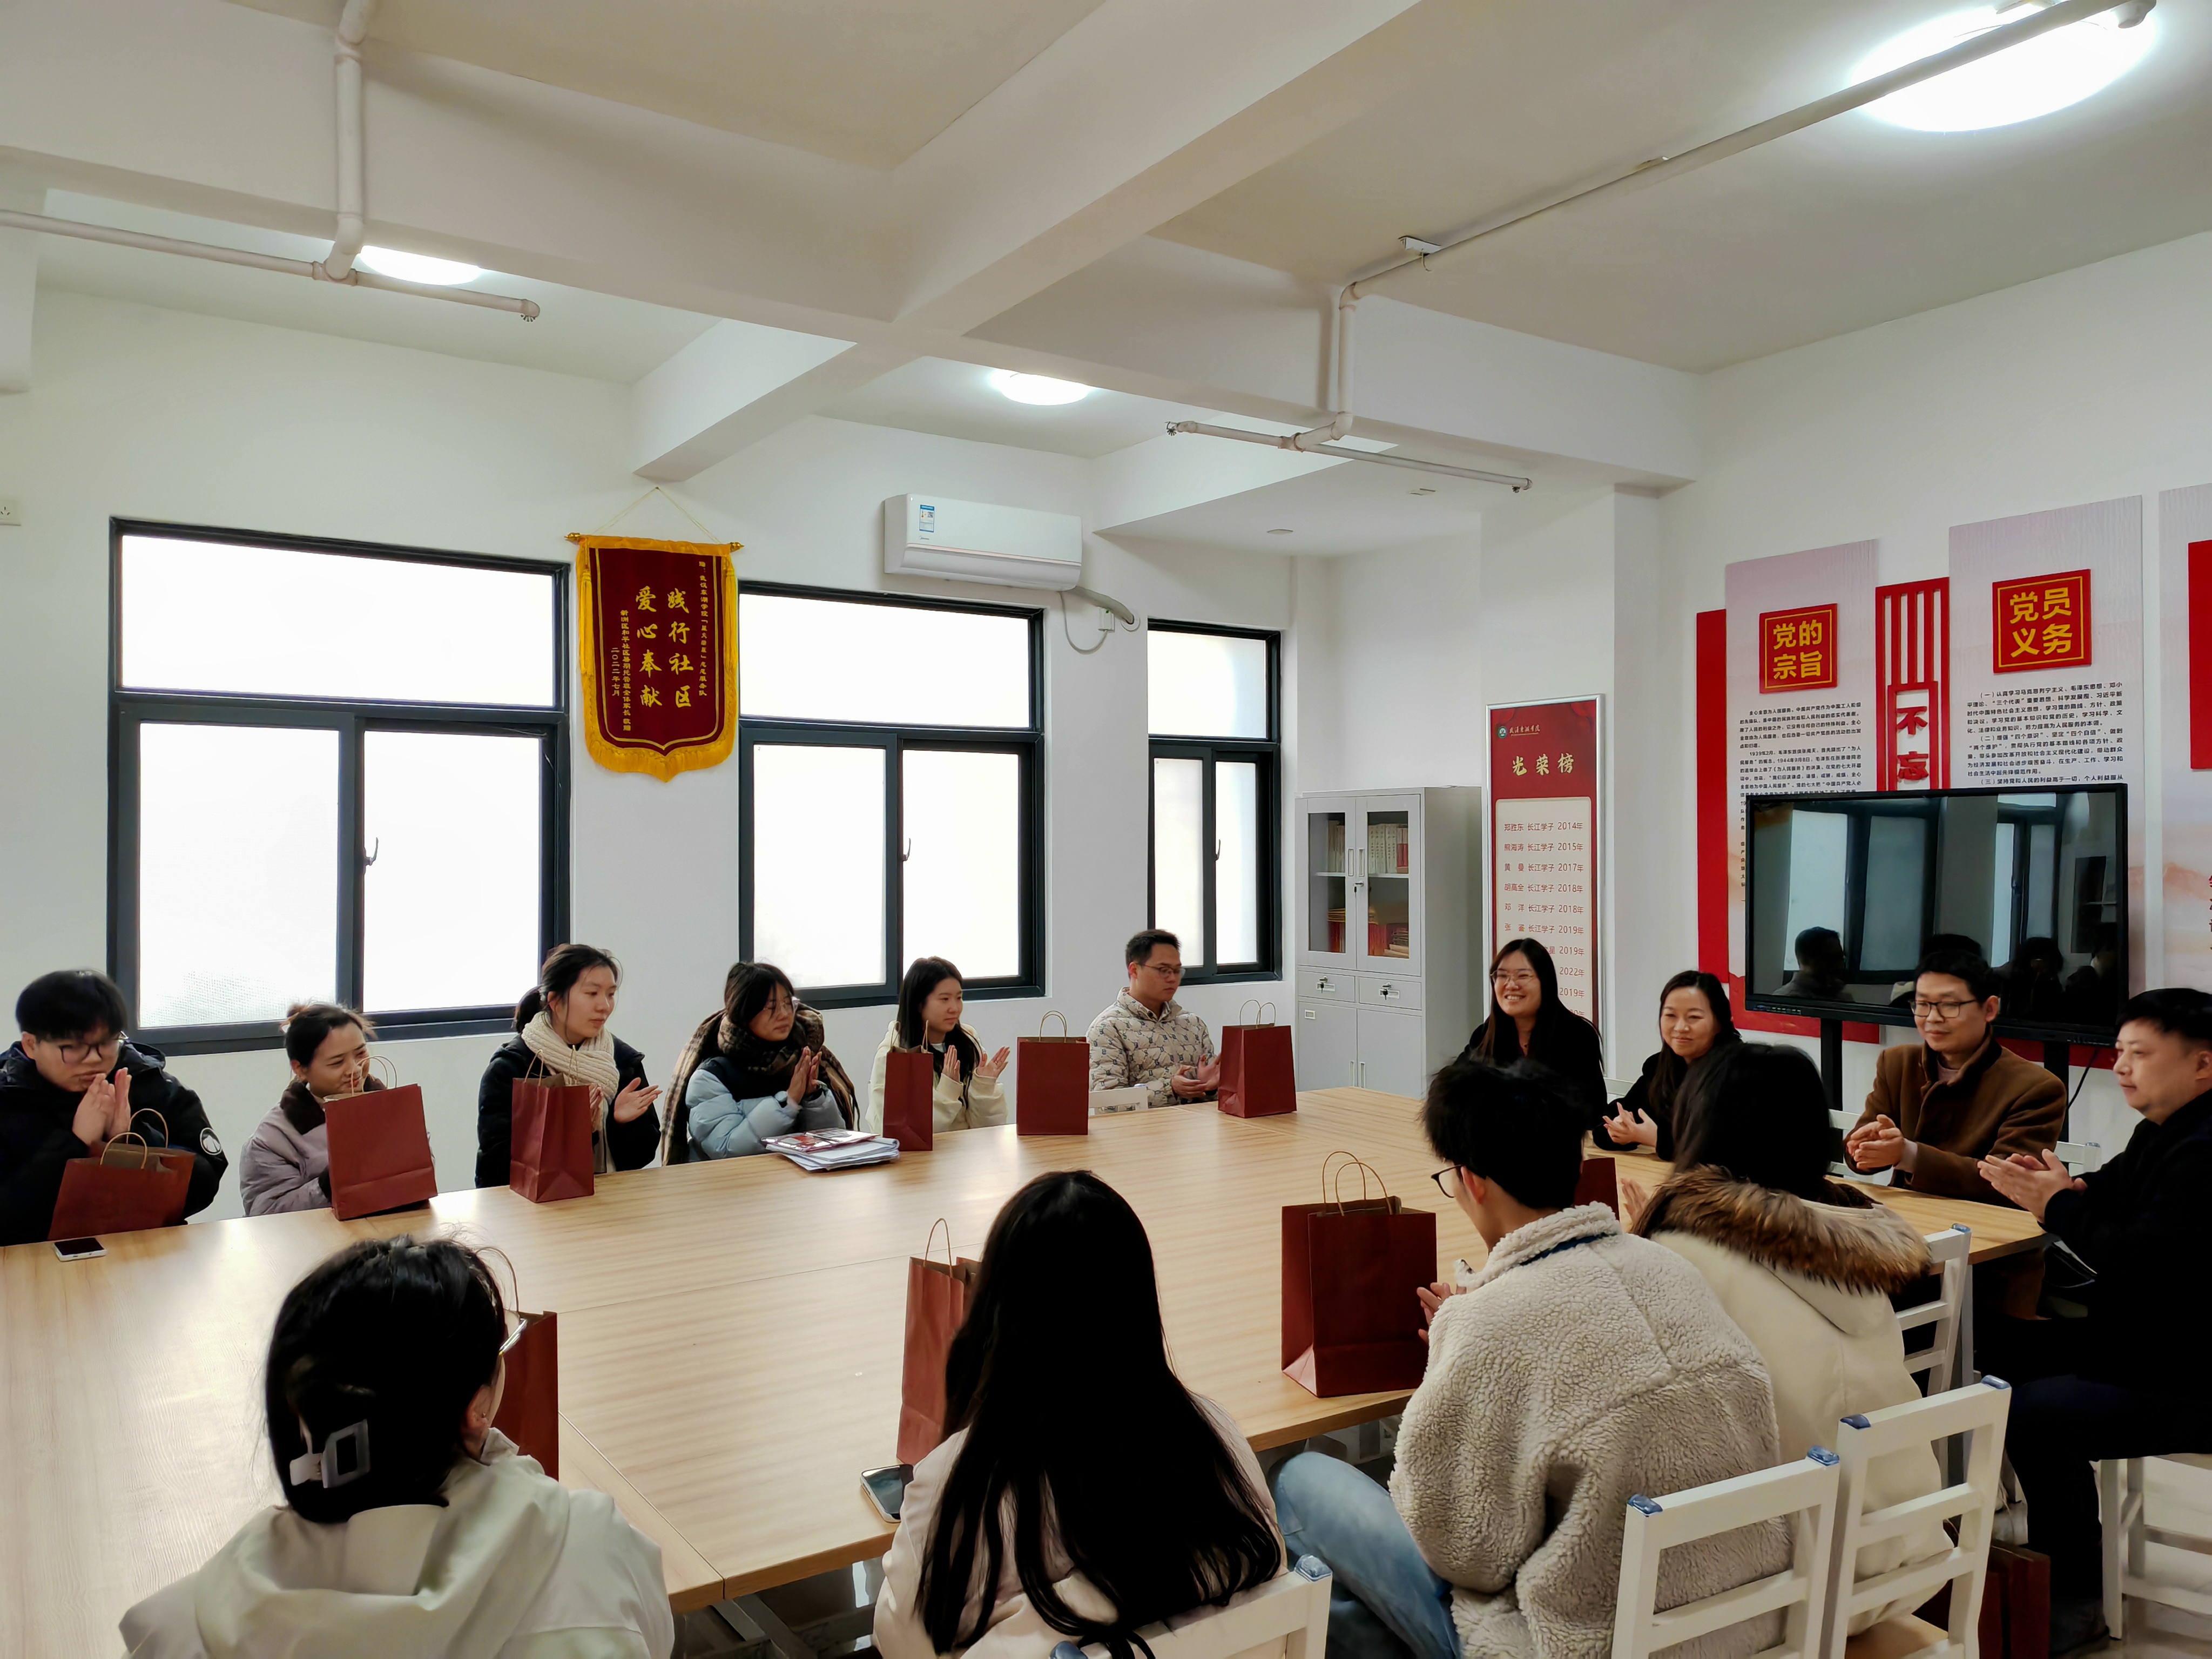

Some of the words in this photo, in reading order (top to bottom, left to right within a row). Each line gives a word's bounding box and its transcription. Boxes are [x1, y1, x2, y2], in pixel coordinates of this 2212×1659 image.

[2009, 587, 2072, 624] 党员
[1773, 620, 1823, 650] 党的
[2010, 624, 2073, 658] 义务
[636, 586, 662, 707] 爱心奉献
[667, 588, 693, 707] 践行社区
[1773, 651, 1823, 680] 宗旨
[1897, 706, 1929, 780] 不忘
[1513, 753, 1574, 776] 光荣榜
[1528, 823, 1554, 831] 长江学子
[1557, 822, 1583, 831] 2014年
[1557, 842, 1584, 851] 2015年
[1528, 864, 1555, 872] 长江学子
[1558, 863, 1584, 872] 2017年
[1528, 884, 1554, 892] 长江学子
[1558, 884, 1583, 893] 2018年
[1528, 904, 1555, 913] 长江学子
[1559, 905, 1584, 914] 2018年
[1528, 925, 1555, 933] 长江学子
[1559, 925, 1584, 935] 2019年
[1559, 946, 1584, 956] 2019年
[1559, 967, 1584, 977] 2022年
[1559, 988, 1584, 998] 2019年
